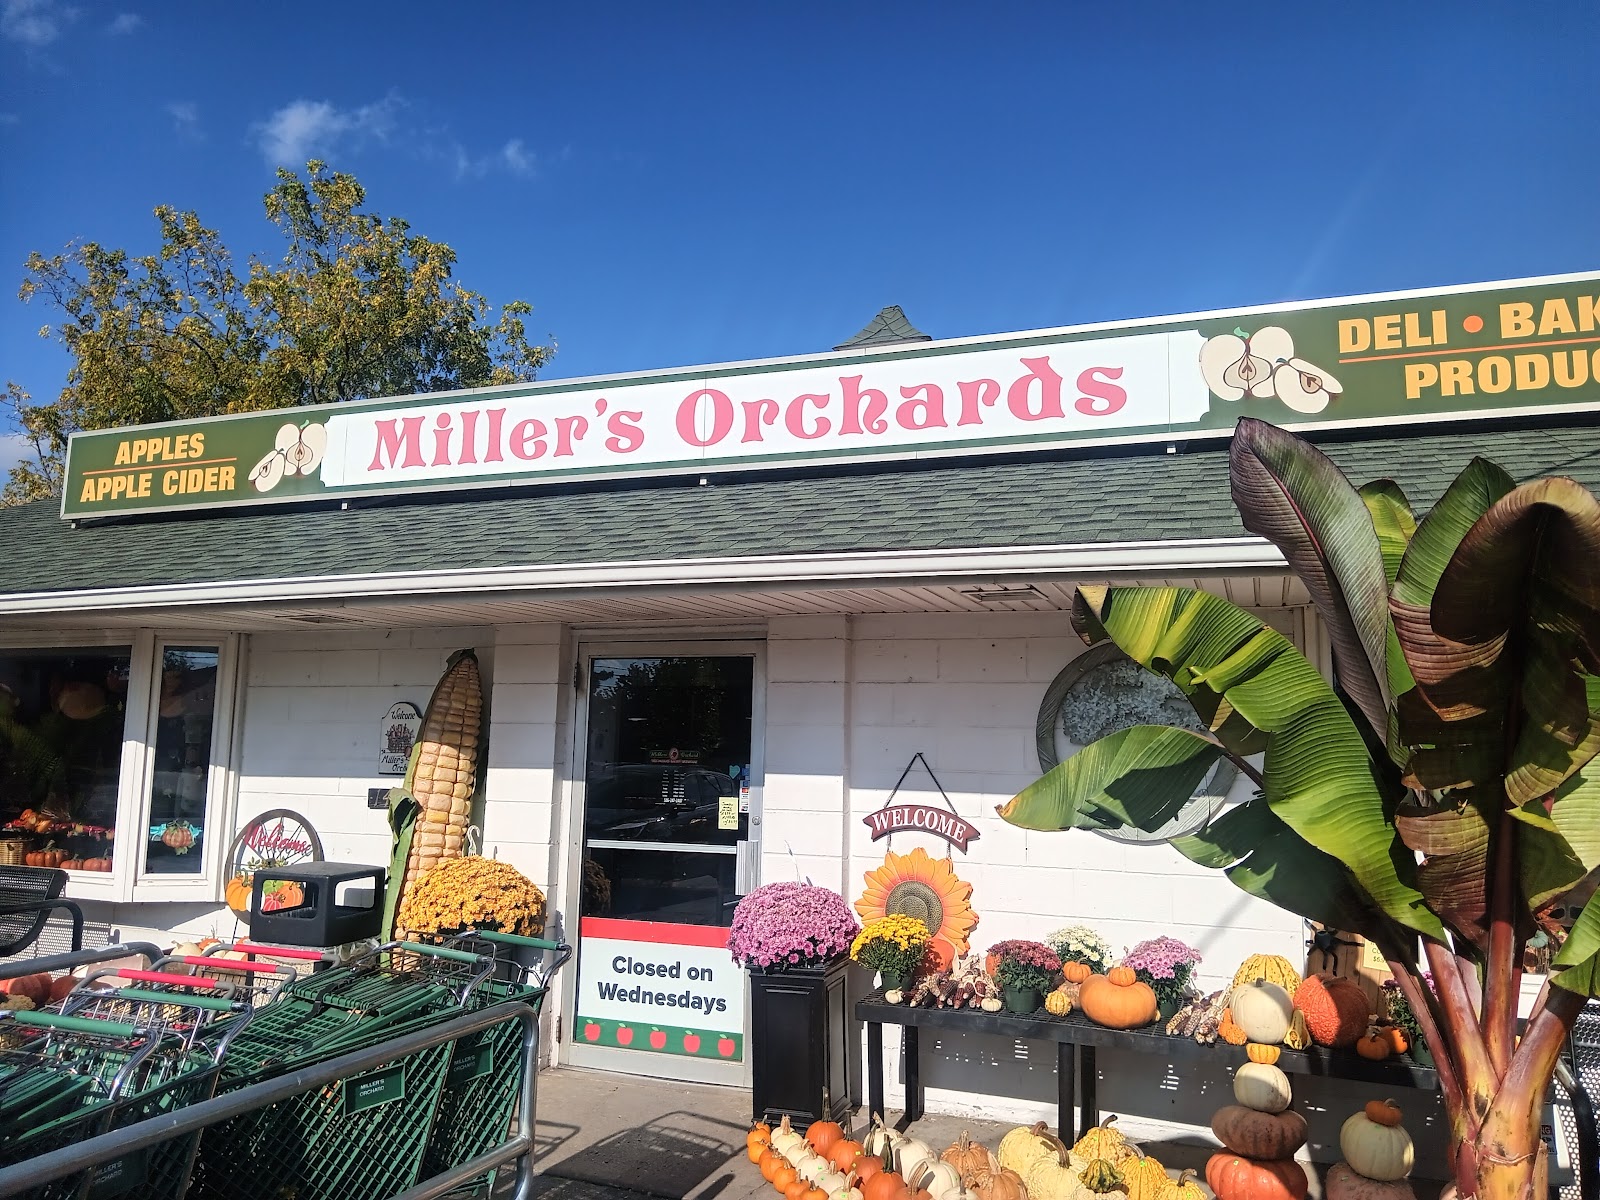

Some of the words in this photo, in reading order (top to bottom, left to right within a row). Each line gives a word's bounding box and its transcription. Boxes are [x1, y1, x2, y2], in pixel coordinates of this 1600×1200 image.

[1338, 309, 1448, 354] DELI
[1404, 348, 1600, 400] PRODU
[367, 398, 645, 472] Miller's
[676, 356, 1128, 447] Orchards
[114, 432, 205, 466] APPLES
[80, 473, 152, 503] APPLE
[162, 465, 236, 496] CIDER
[871, 807, 967, 843] WELCOME
[611, 955, 681, 979] Closed
[686, 967, 713, 982] on
[597, 981, 727, 1015] Wednesdays
[359, 1085, 385, 1097] ORCHARD
[360, 1078, 385, 1090] MILLER'S
